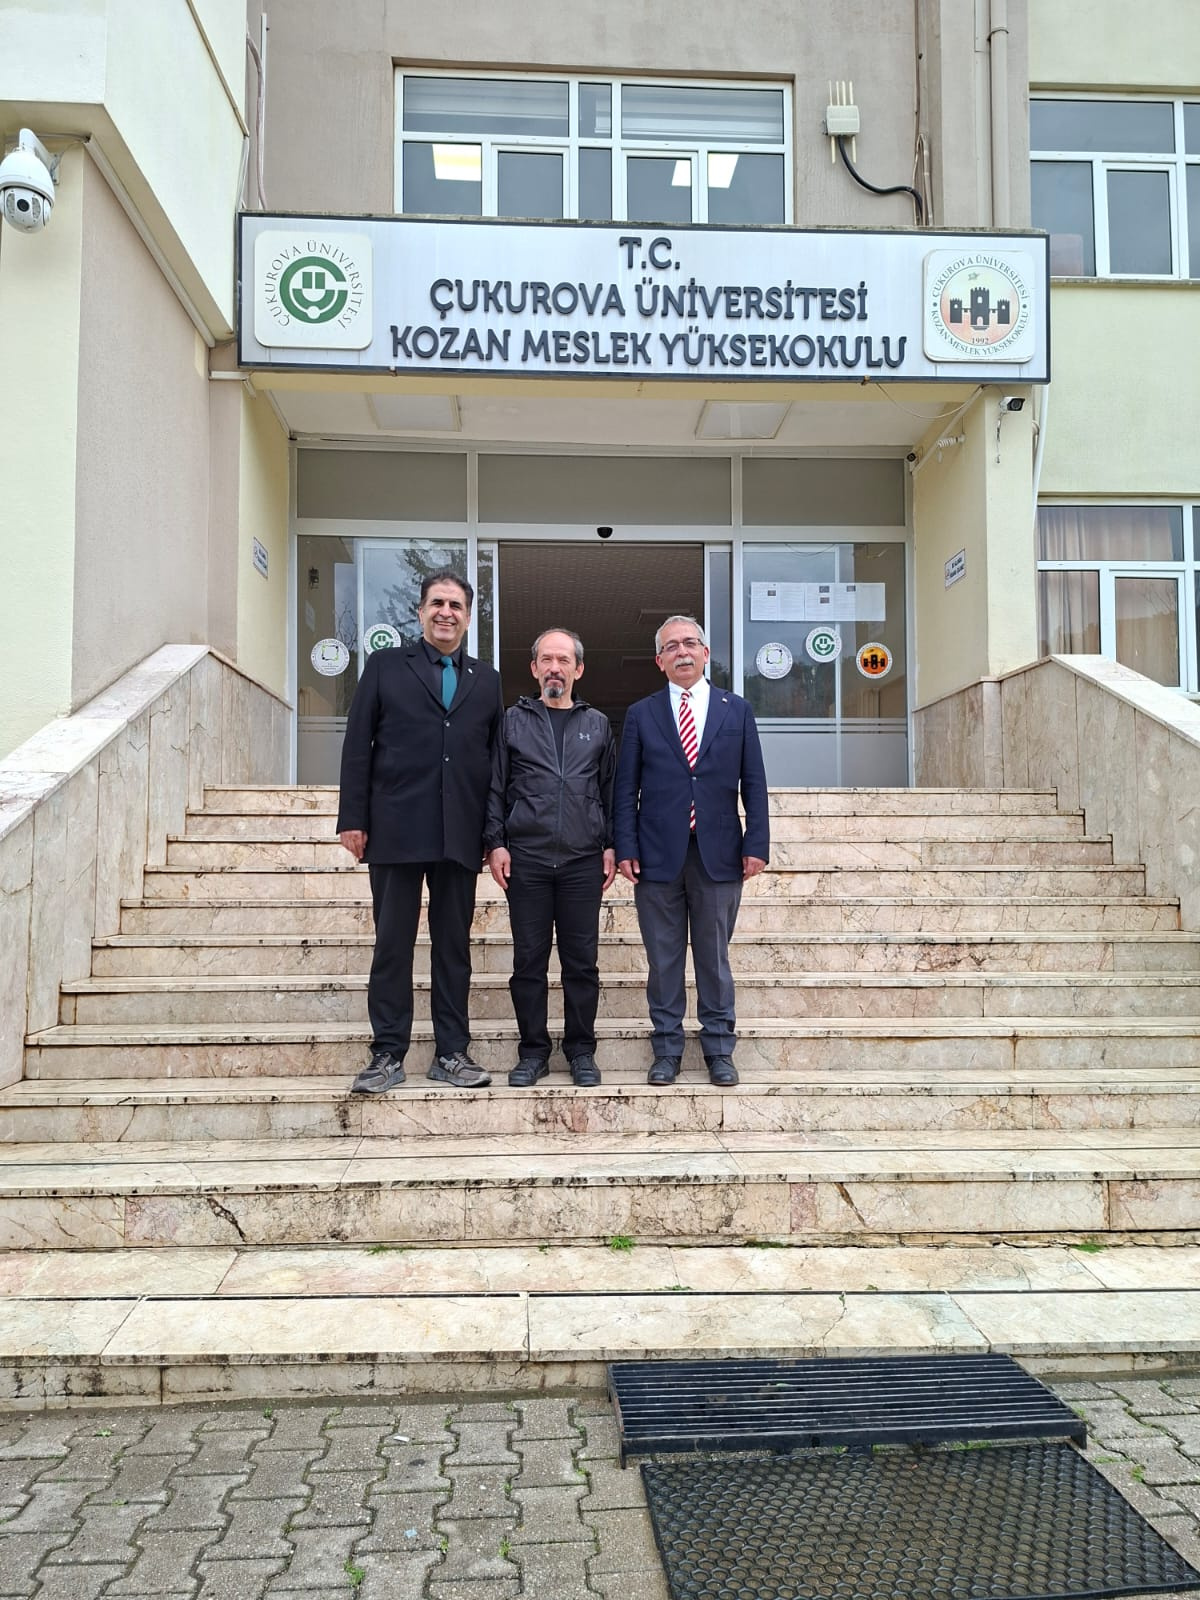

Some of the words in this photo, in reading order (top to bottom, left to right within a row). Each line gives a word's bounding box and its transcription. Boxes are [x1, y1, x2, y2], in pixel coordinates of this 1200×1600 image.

[619, 236, 681, 270] T.C.
[264, 245, 301, 327] ÇUKUROVA
[430, 278, 626, 320] ÇUKUROVA
[635, 277, 868, 321] ÜNİVERSİTESİ
[390, 325, 511, 361] KOZAN
[521, 330, 652, 364] MESLEK
[659, 325, 907, 369] YÜKSEKOKULU
